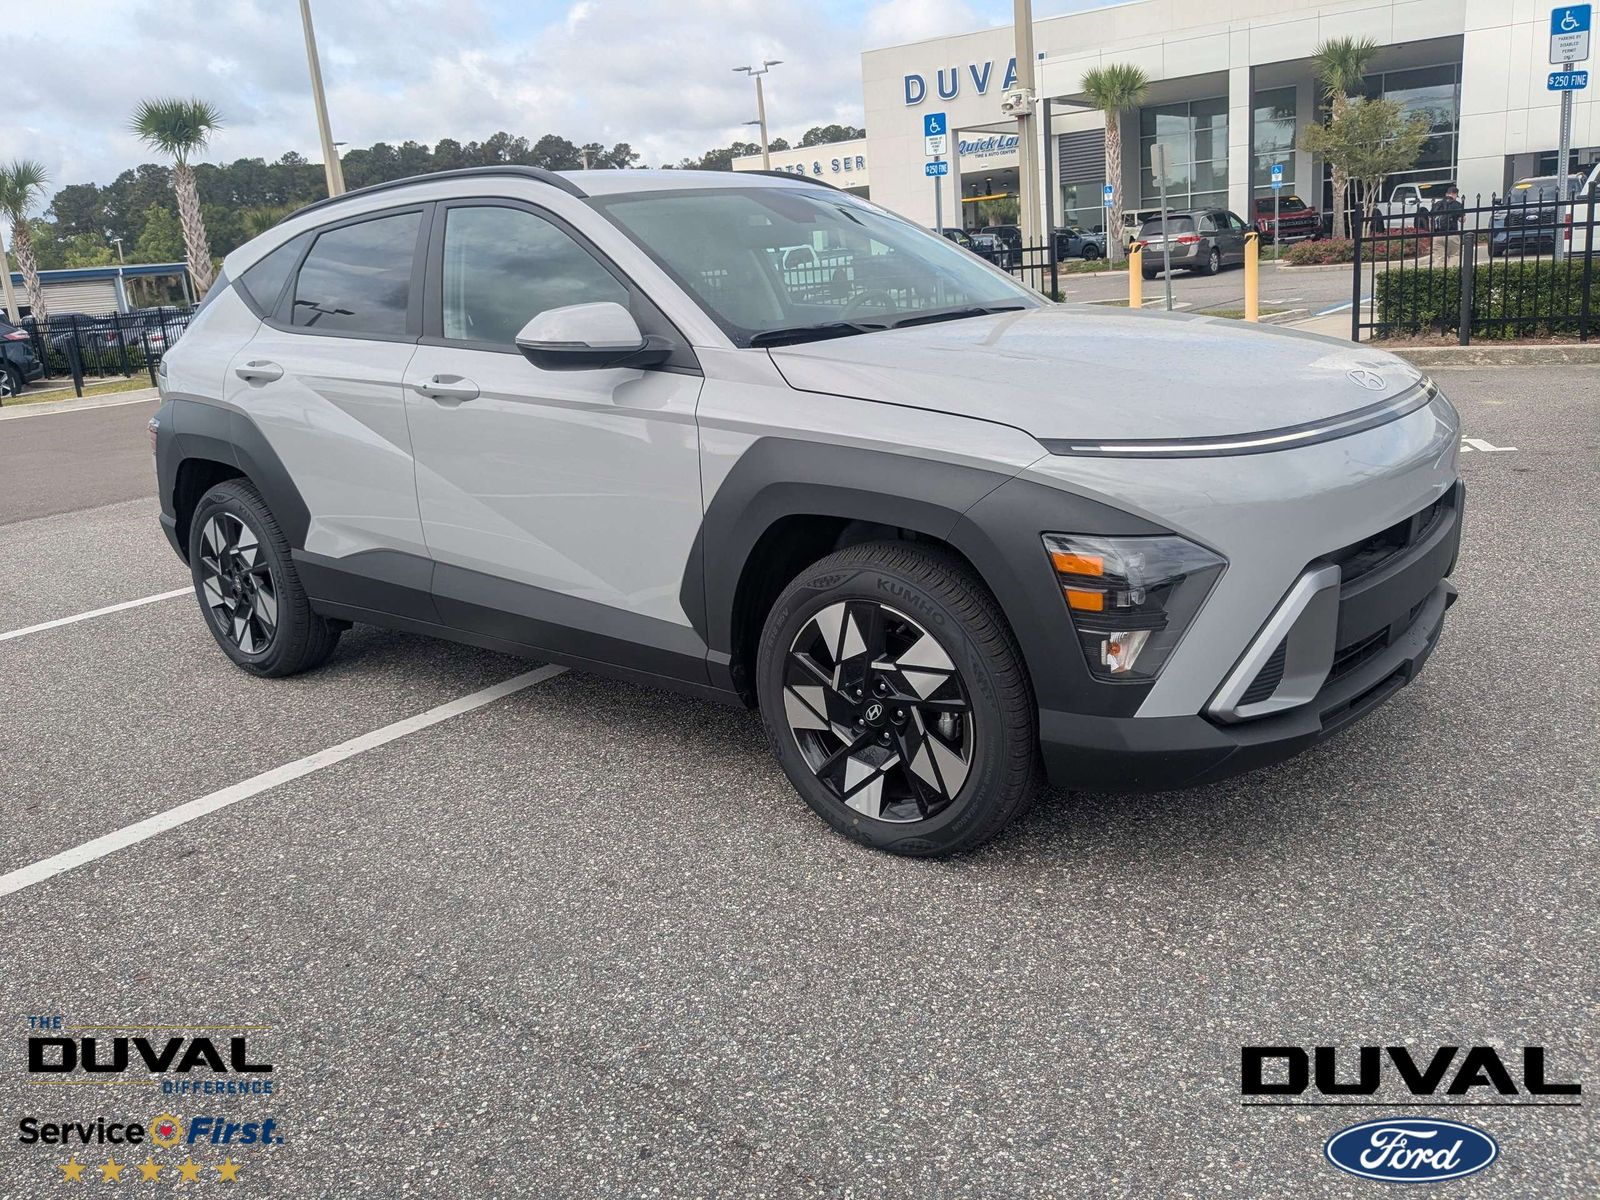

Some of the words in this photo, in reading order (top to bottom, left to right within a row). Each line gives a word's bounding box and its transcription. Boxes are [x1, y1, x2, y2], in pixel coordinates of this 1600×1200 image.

[1548, 75, 1569, 87] $250
[1570, 74, 1586, 86] FINE
[959, 137, 998, 155] Quick
[813, 161, 822, 175] &
[877, 577, 946, 627] KUMHO
